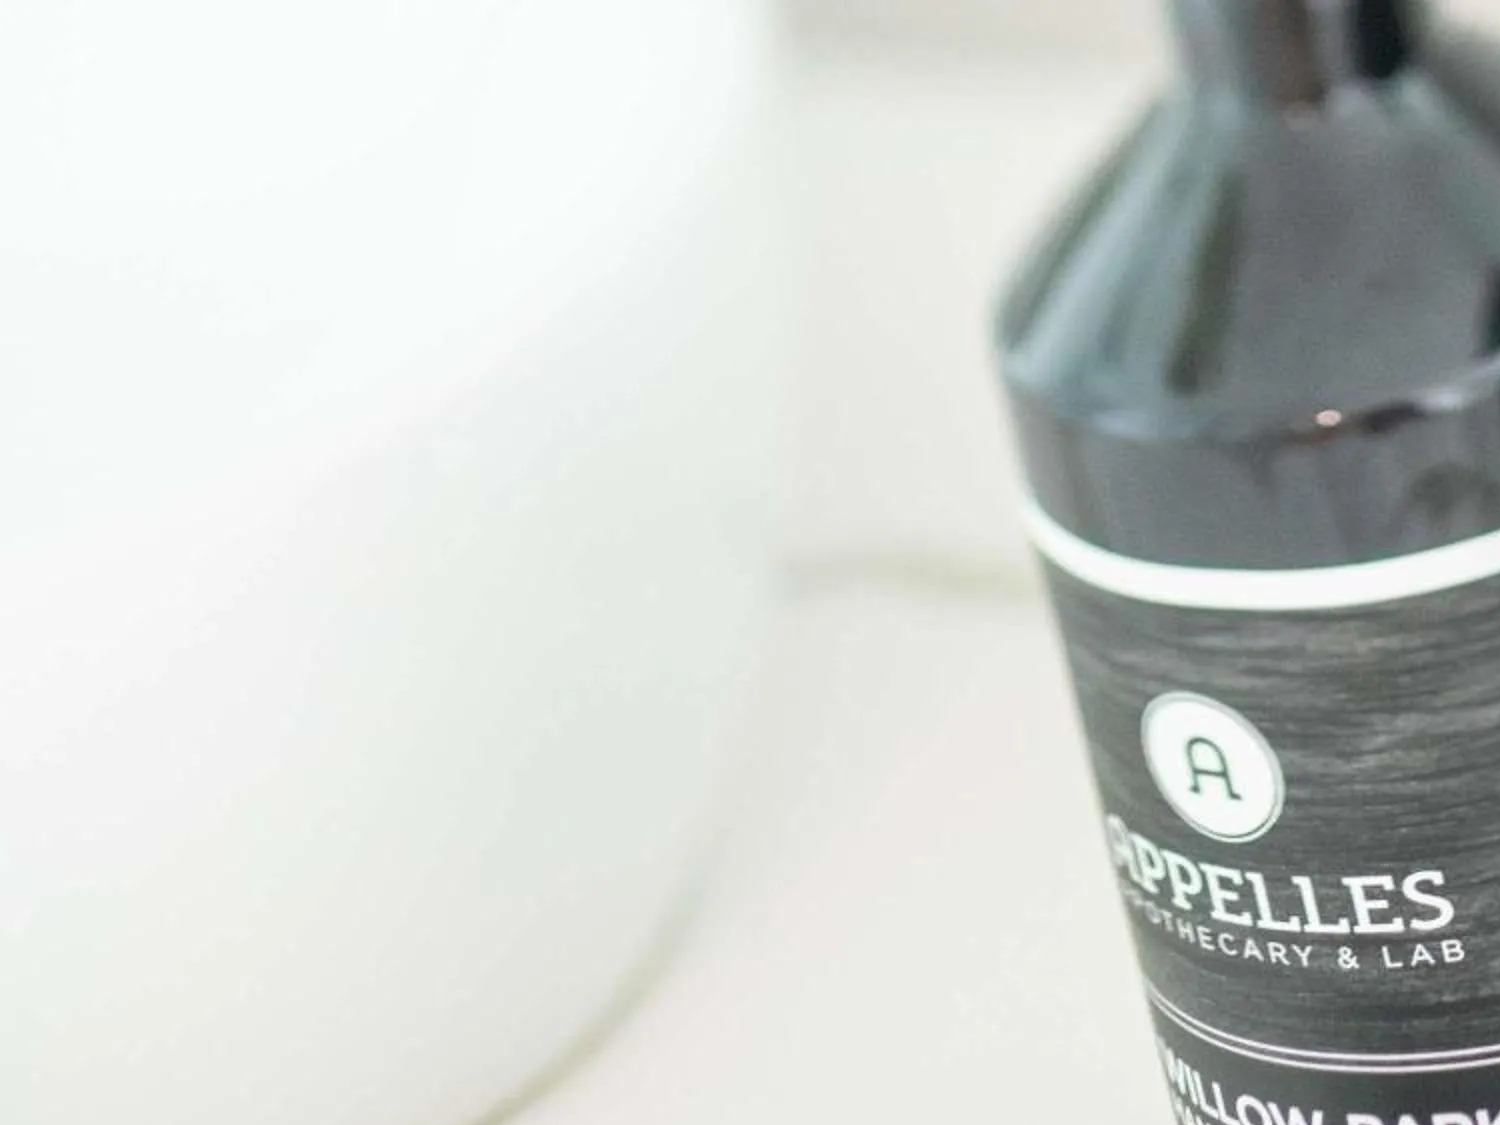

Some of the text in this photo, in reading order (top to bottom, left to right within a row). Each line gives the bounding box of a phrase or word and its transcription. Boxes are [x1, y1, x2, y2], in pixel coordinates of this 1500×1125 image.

[1186, 736, 1243, 800] A
[1336, 945, 1361, 970] &
[1383, 939, 1467, 969] LAB
